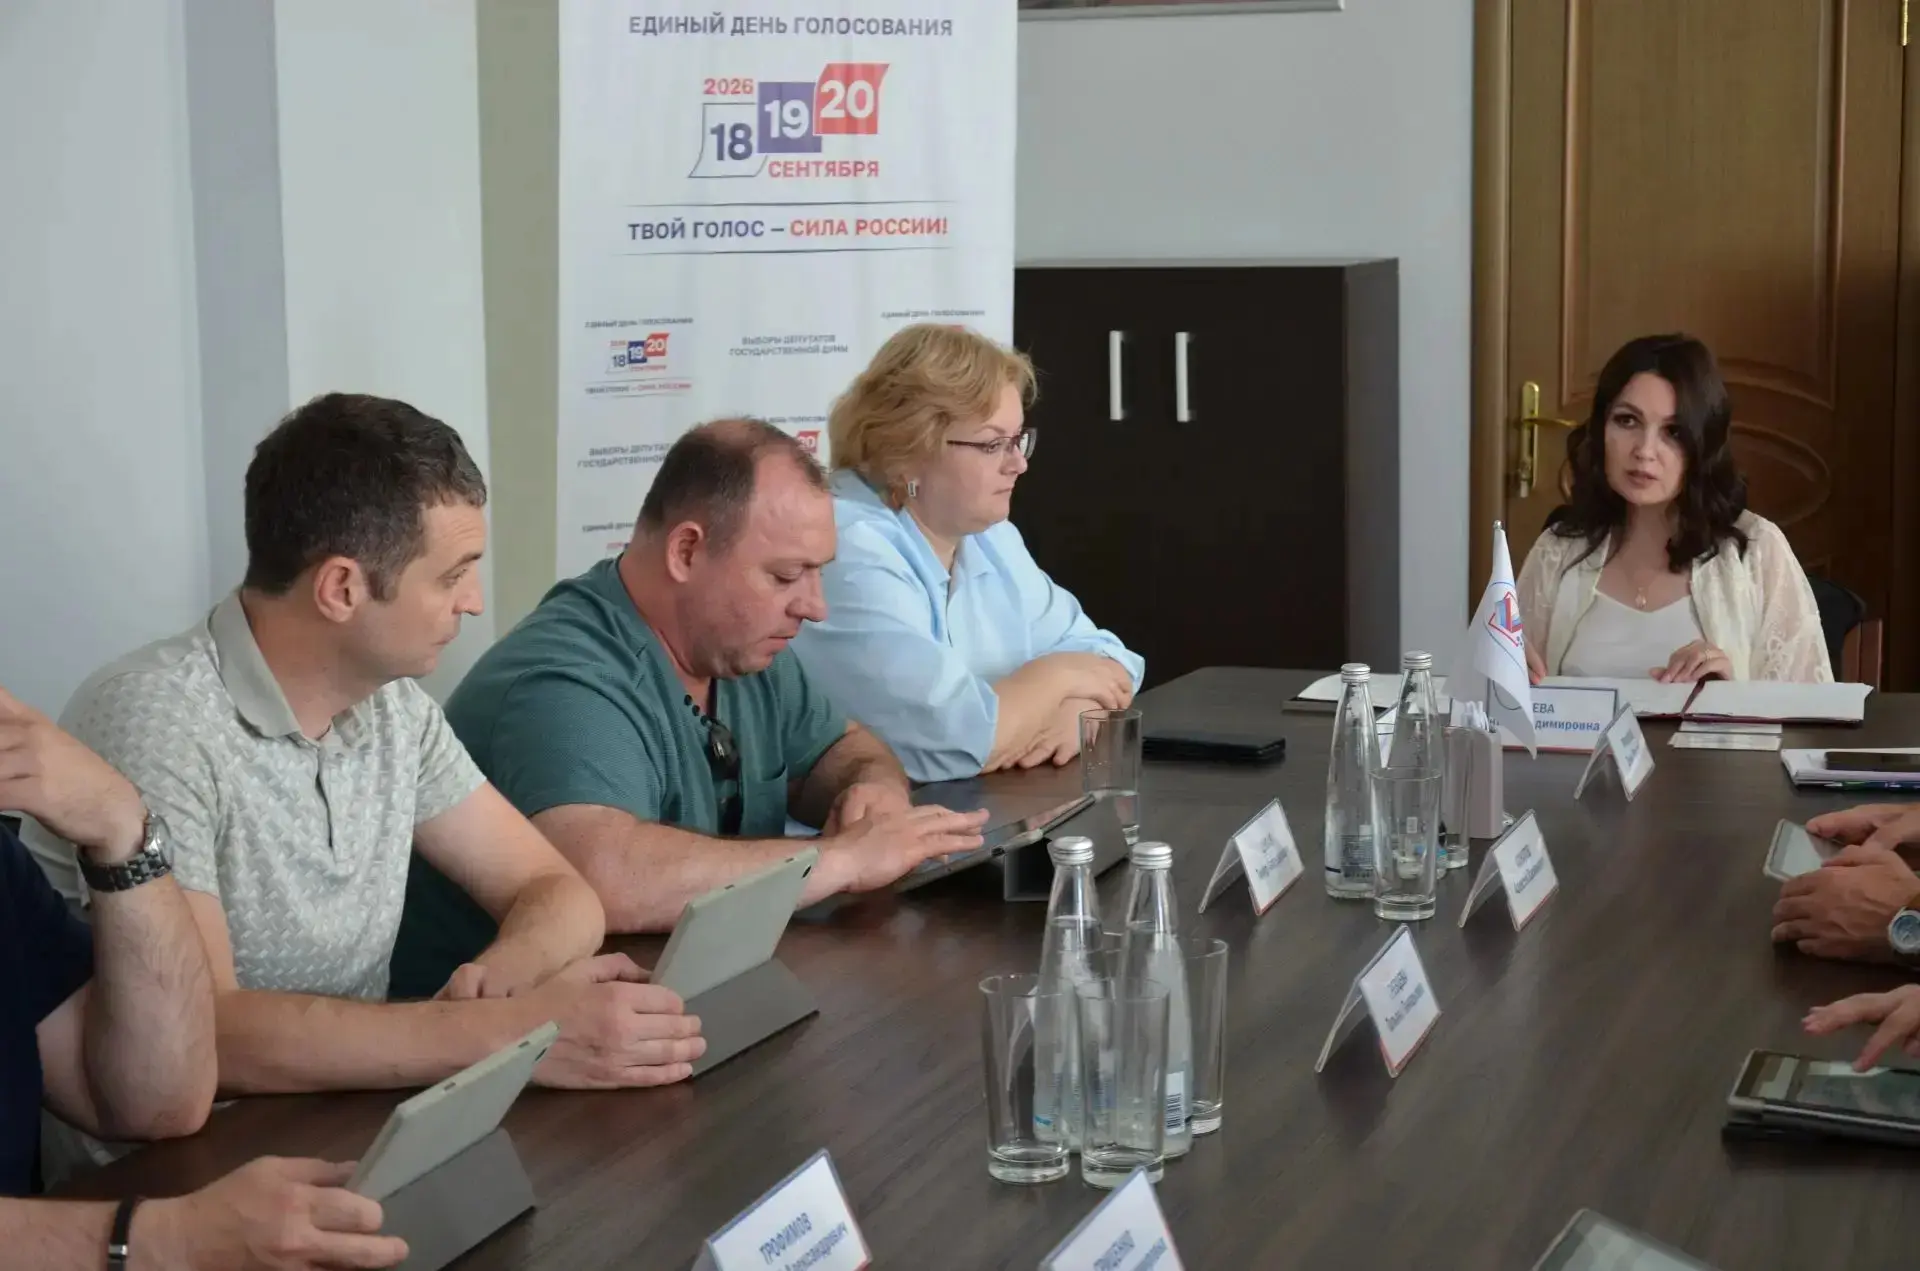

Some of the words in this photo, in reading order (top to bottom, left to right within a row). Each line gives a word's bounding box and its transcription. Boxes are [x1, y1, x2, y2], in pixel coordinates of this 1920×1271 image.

[629, 11, 725, 36] ЕДИНЫЙ
[730, 16, 788, 36] ДЕНЬ
[794, 17, 953, 35] ГОЛОСОВАНИЯ
[703, 78, 753, 95] 2026
[820, 80, 875, 118] 20
[764, 99, 809, 139] 19
[710, 122, 753, 161] 18
[768, 160, 879, 178] СЕНТЯБРЯ
[628, 217, 686, 240] ТВОЙ
[693, 220, 765, 239] ГОЛОС
[790, 219, 848, 236] СИЛА
[855, 217, 948, 235] РОССИИ!
[629, 346, 644, 360] 19
[646, 338, 665, 353] 20
[612, 354, 626, 367] 18
[630, 443, 671, 454] ДЕПУТАТ
[1532, 702, 1555, 714] ЕВА
[1535, 720, 1600, 731] димировна
[759, 1212, 812, 1266] ТРОФИМОВ
